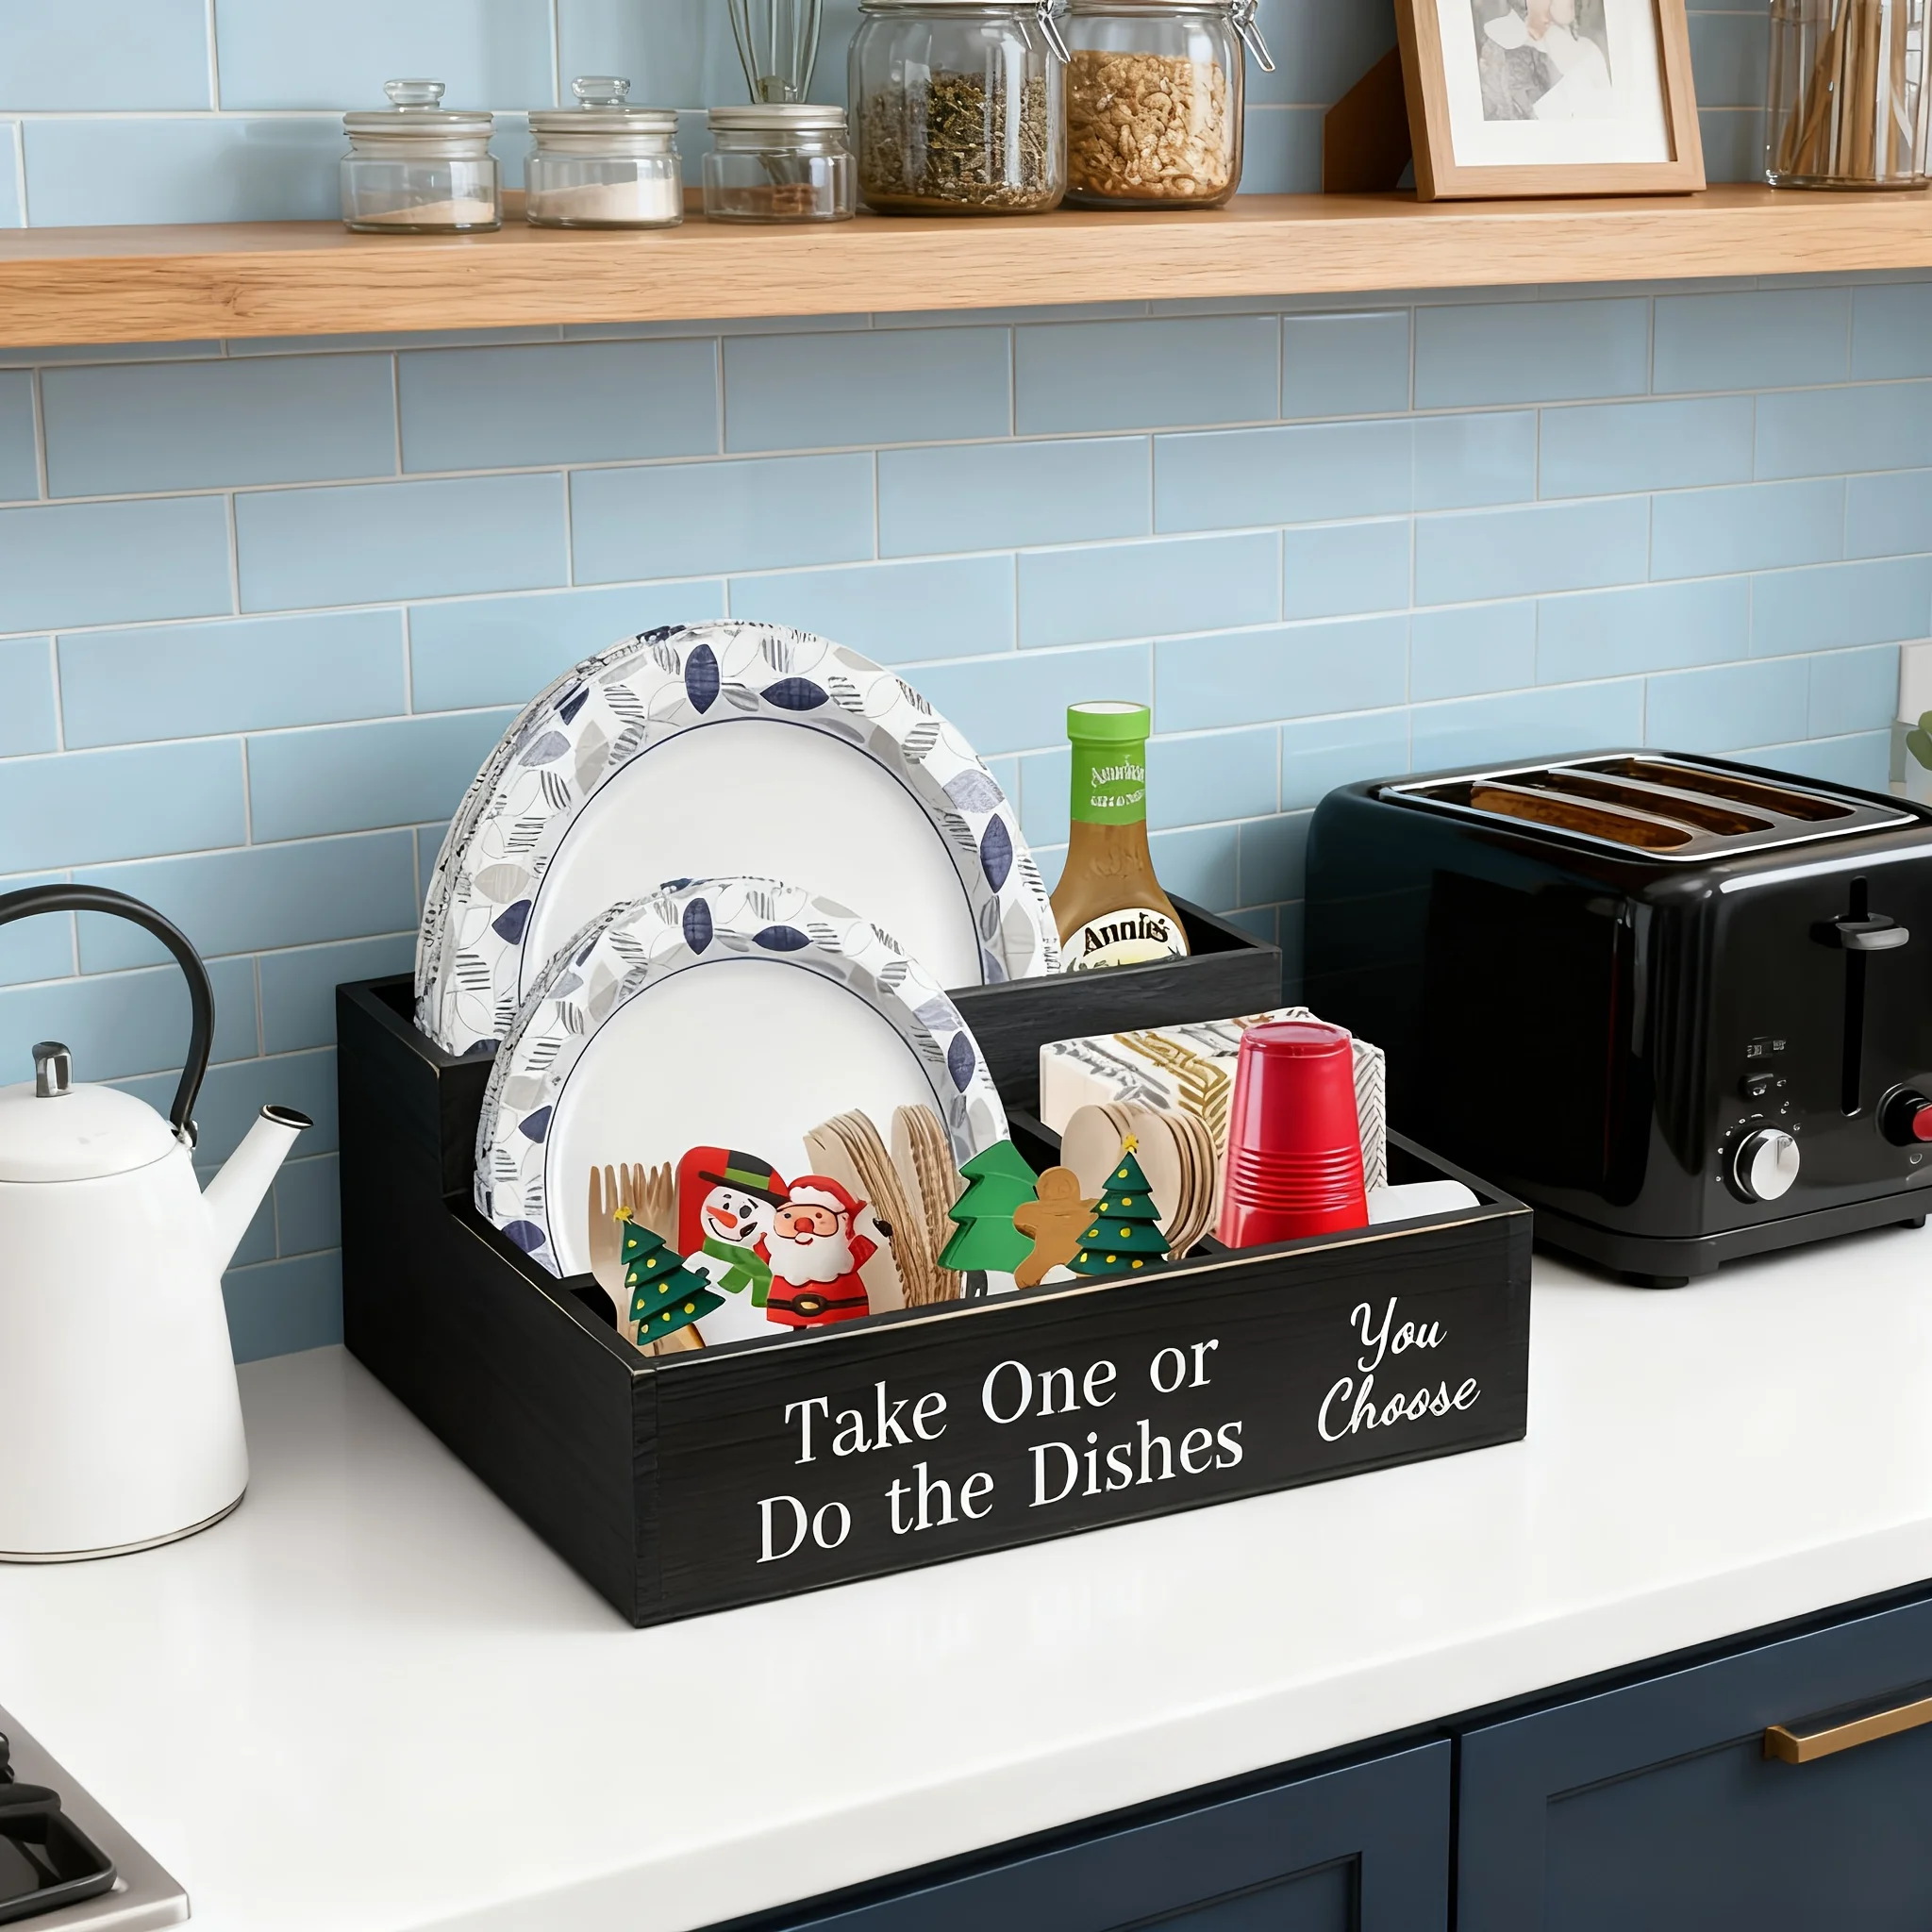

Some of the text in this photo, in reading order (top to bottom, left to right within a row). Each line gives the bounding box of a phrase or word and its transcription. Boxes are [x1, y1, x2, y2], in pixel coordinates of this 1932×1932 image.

[1350, 1296, 1448, 1373] You
[784, 1339, 1220, 1465] Take One or
[1317, 1374, 1481, 1442] Choose
[756, 1418, 1243, 1564] Do the Dishes
